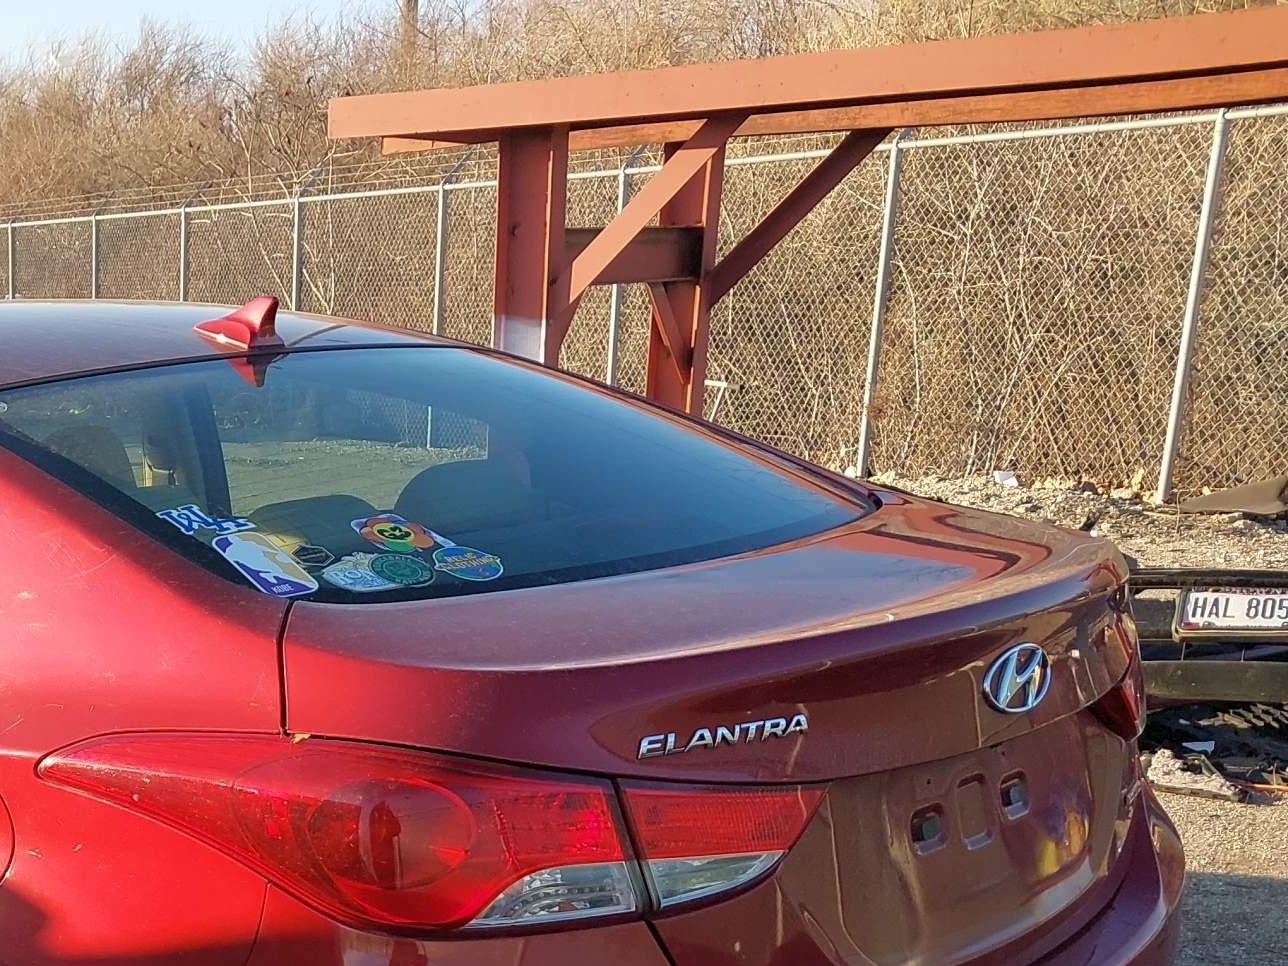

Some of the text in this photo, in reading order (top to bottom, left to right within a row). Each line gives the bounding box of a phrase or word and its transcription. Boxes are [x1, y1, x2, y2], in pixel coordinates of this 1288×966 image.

[272, 583, 294, 593] KOBE
[1191, 596, 1235, 618] HAL
[637, 713, 809, 760] ELANTRA
